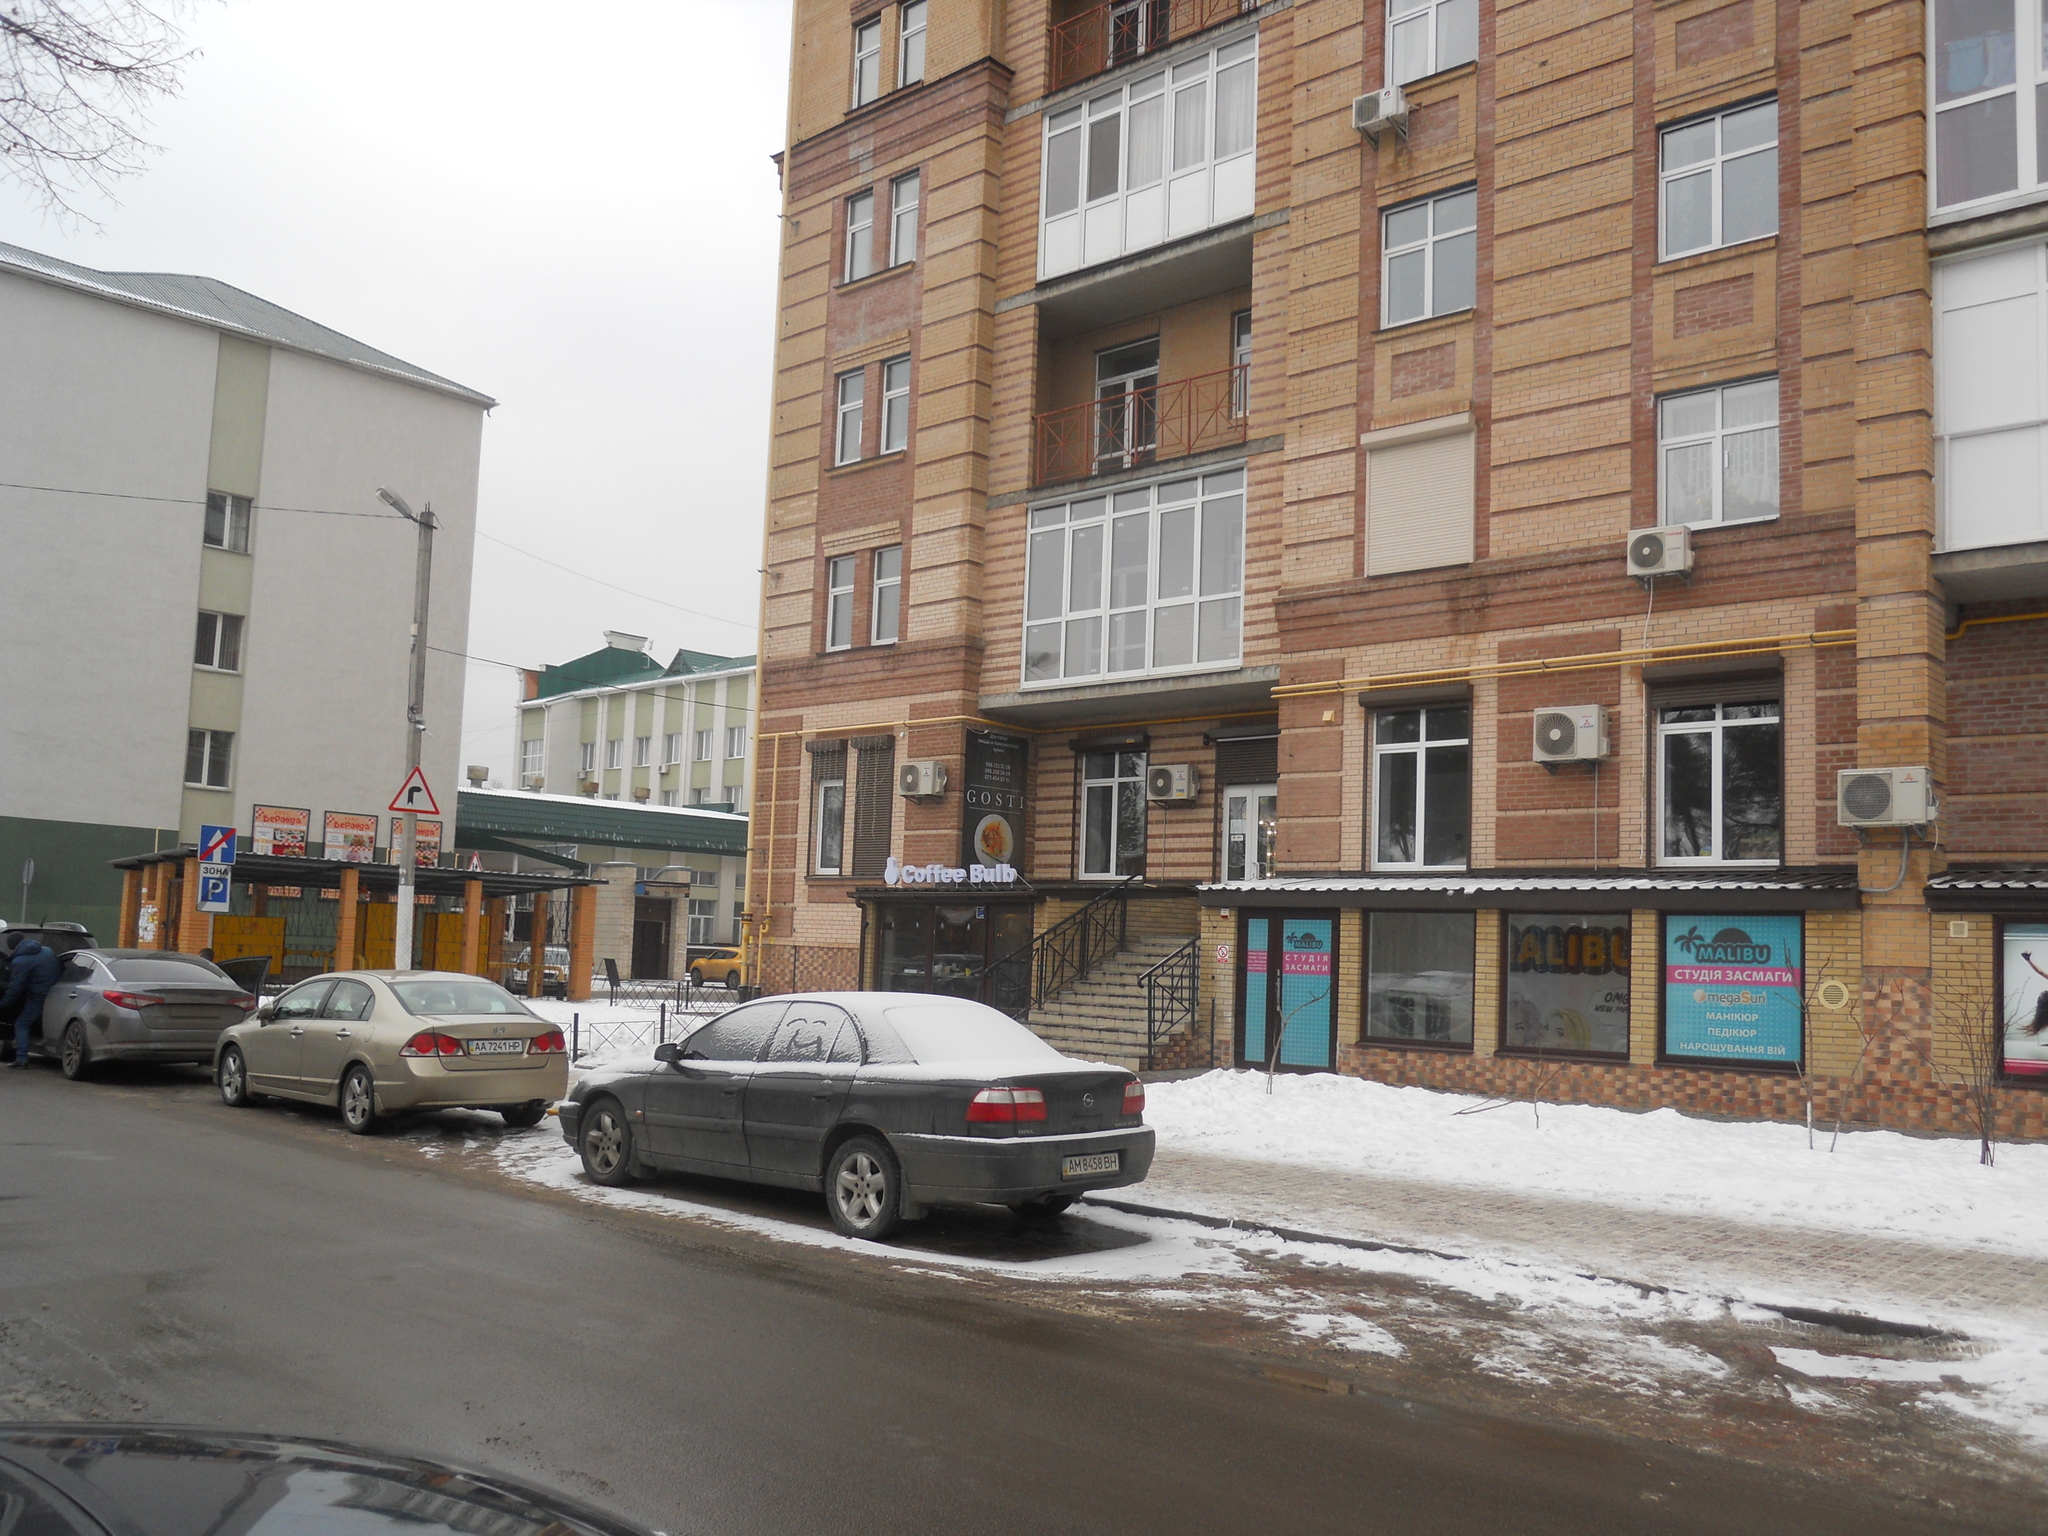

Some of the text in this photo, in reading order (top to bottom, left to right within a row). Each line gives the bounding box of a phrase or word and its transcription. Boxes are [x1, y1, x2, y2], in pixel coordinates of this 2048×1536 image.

[966, 789, 1025, 809] GOSTI
[901, 863, 1018, 884] Coffee Bulb
[1294, 941, 1322, 949] MALIBU
[1285, 954, 1328, 963] СТУДІЯ
[1697, 946, 1769, 962] MALIBU
[1285, 963, 1328, 972] ЗАСМАГИ
[1674, 969, 1793, 982] СТУДІЯ ЗАСМАГИ
[1705, 1011, 1759, 1022] МАНІКЮР
[1707, 1027, 1757, 1038] ПЕДІКЮР
[475, 1041, 520, 1051] AA 7241 HP
[1680, 1041, 1786, 1055] НАРОЩУВАННЯ ВІЙ
[1068, 1155, 1117, 1173] AM 8458 BH
